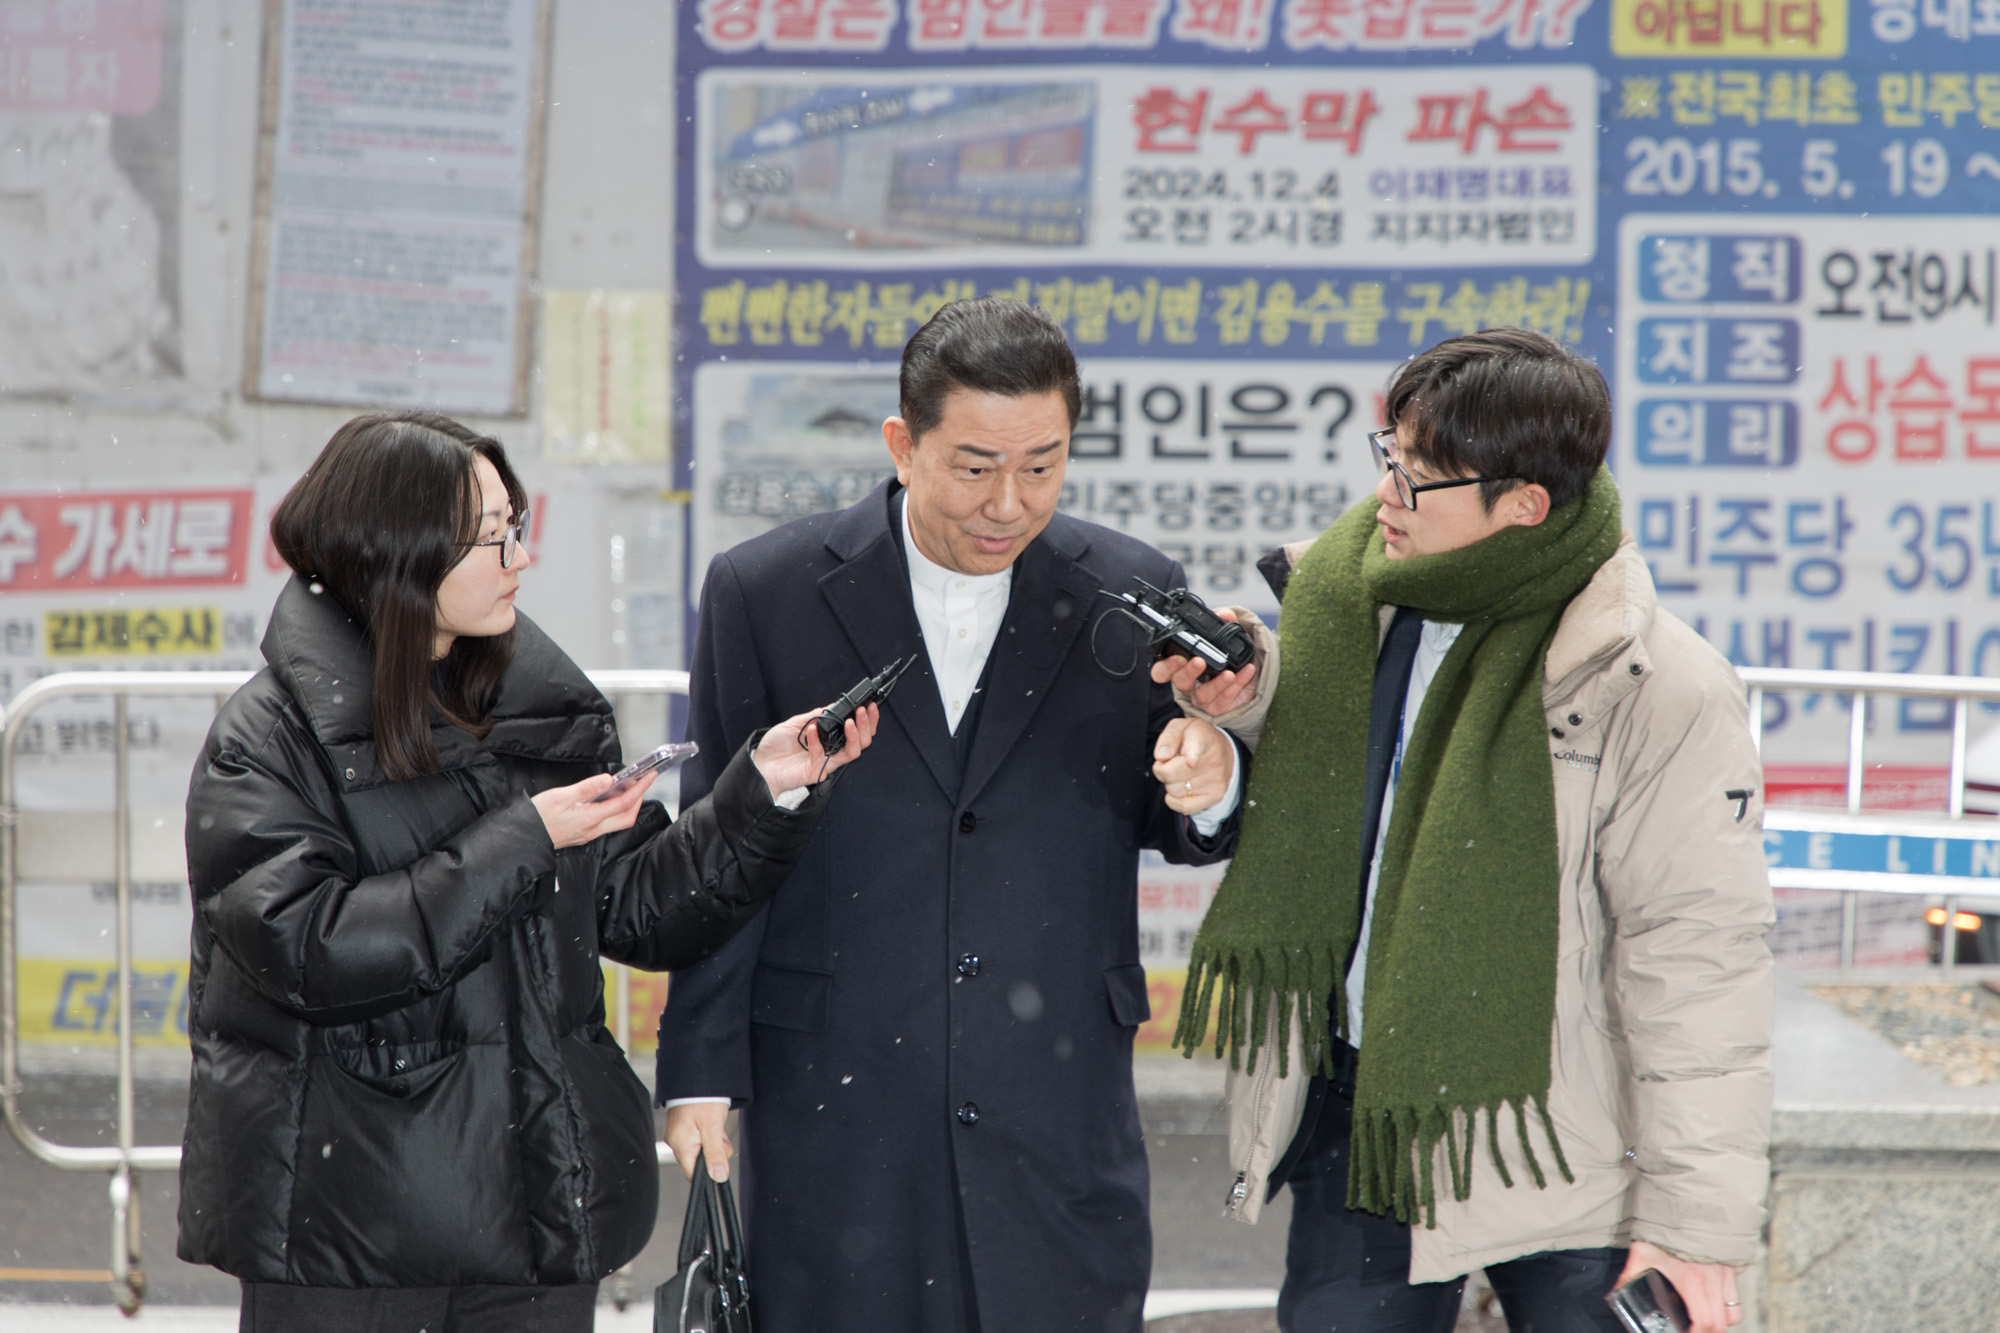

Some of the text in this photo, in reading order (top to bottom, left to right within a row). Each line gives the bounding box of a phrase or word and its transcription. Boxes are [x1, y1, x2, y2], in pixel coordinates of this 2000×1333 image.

[1132, 86, 1380, 156] 현수막
[1406, 86, 1572, 156] 파손
[1123, 166, 1574, 202] 2024.12.4 이재명대표
[1624, 138, 1781, 199] 2015.
[1802, 140, 1856, 198] 5.
[1881, 139, 1949, 199] 19
[1123, 208, 1211, 245] 오전
[1817, 249, 1996, 326] 오전9시
[53, 499, 234, 581] 가세로
[1639, 496, 1854, 597] 민주당
